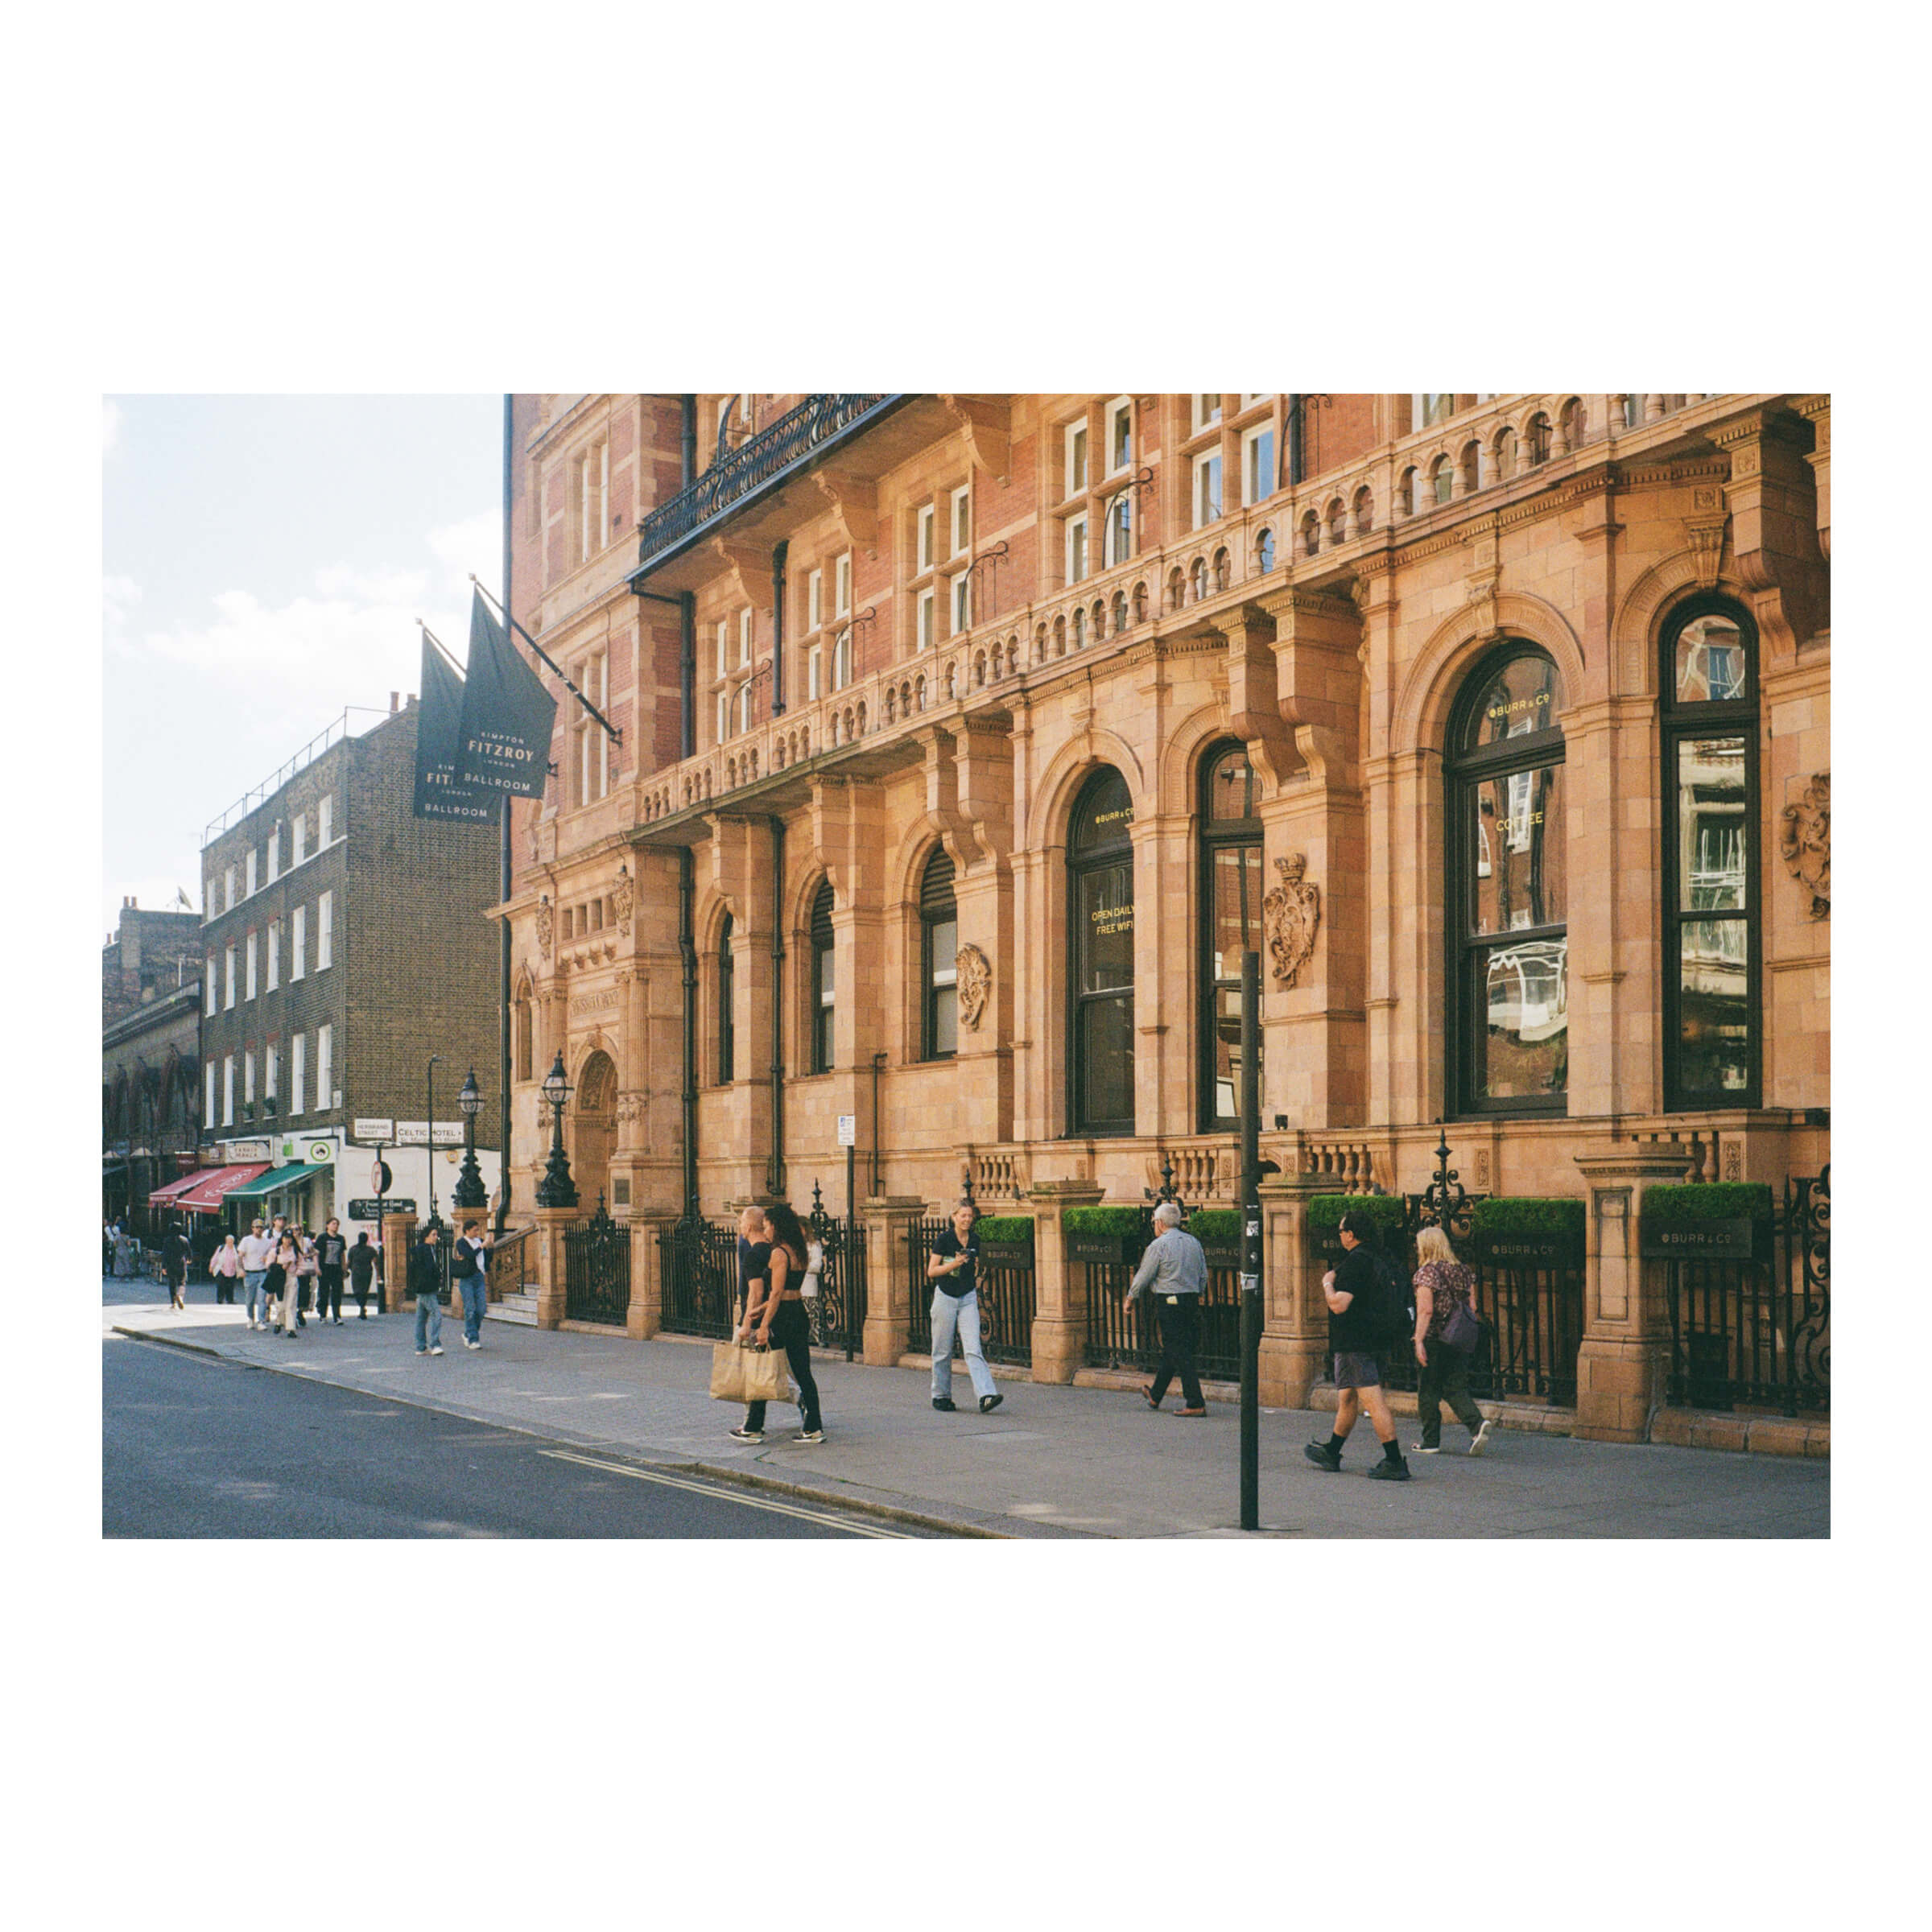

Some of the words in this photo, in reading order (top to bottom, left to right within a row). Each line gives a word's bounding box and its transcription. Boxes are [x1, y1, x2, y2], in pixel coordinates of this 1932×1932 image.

[1497, 700, 1526, 716] BURR
[468, 740, 534, 762] FITZROY
[427, 772, 454, 786] FIT
[464, 773, 530, 791] BALLROOM
[424, 803, 487, 818] BALLROOM
[1101, 811, 1120, 823] BURR
[1496, 811, 1544, 832] COEE
[1091, 909, 1113, 922] OPEN
[1113, 904, 1134, 917] DAILY
[1096, 923, 1116, 936] FREE
[398, 1128, 427, 1137] CELTIC
[1671, 1232, 1705, 1244] BURR
[1501, 1245, 1530, 1255] BURR
